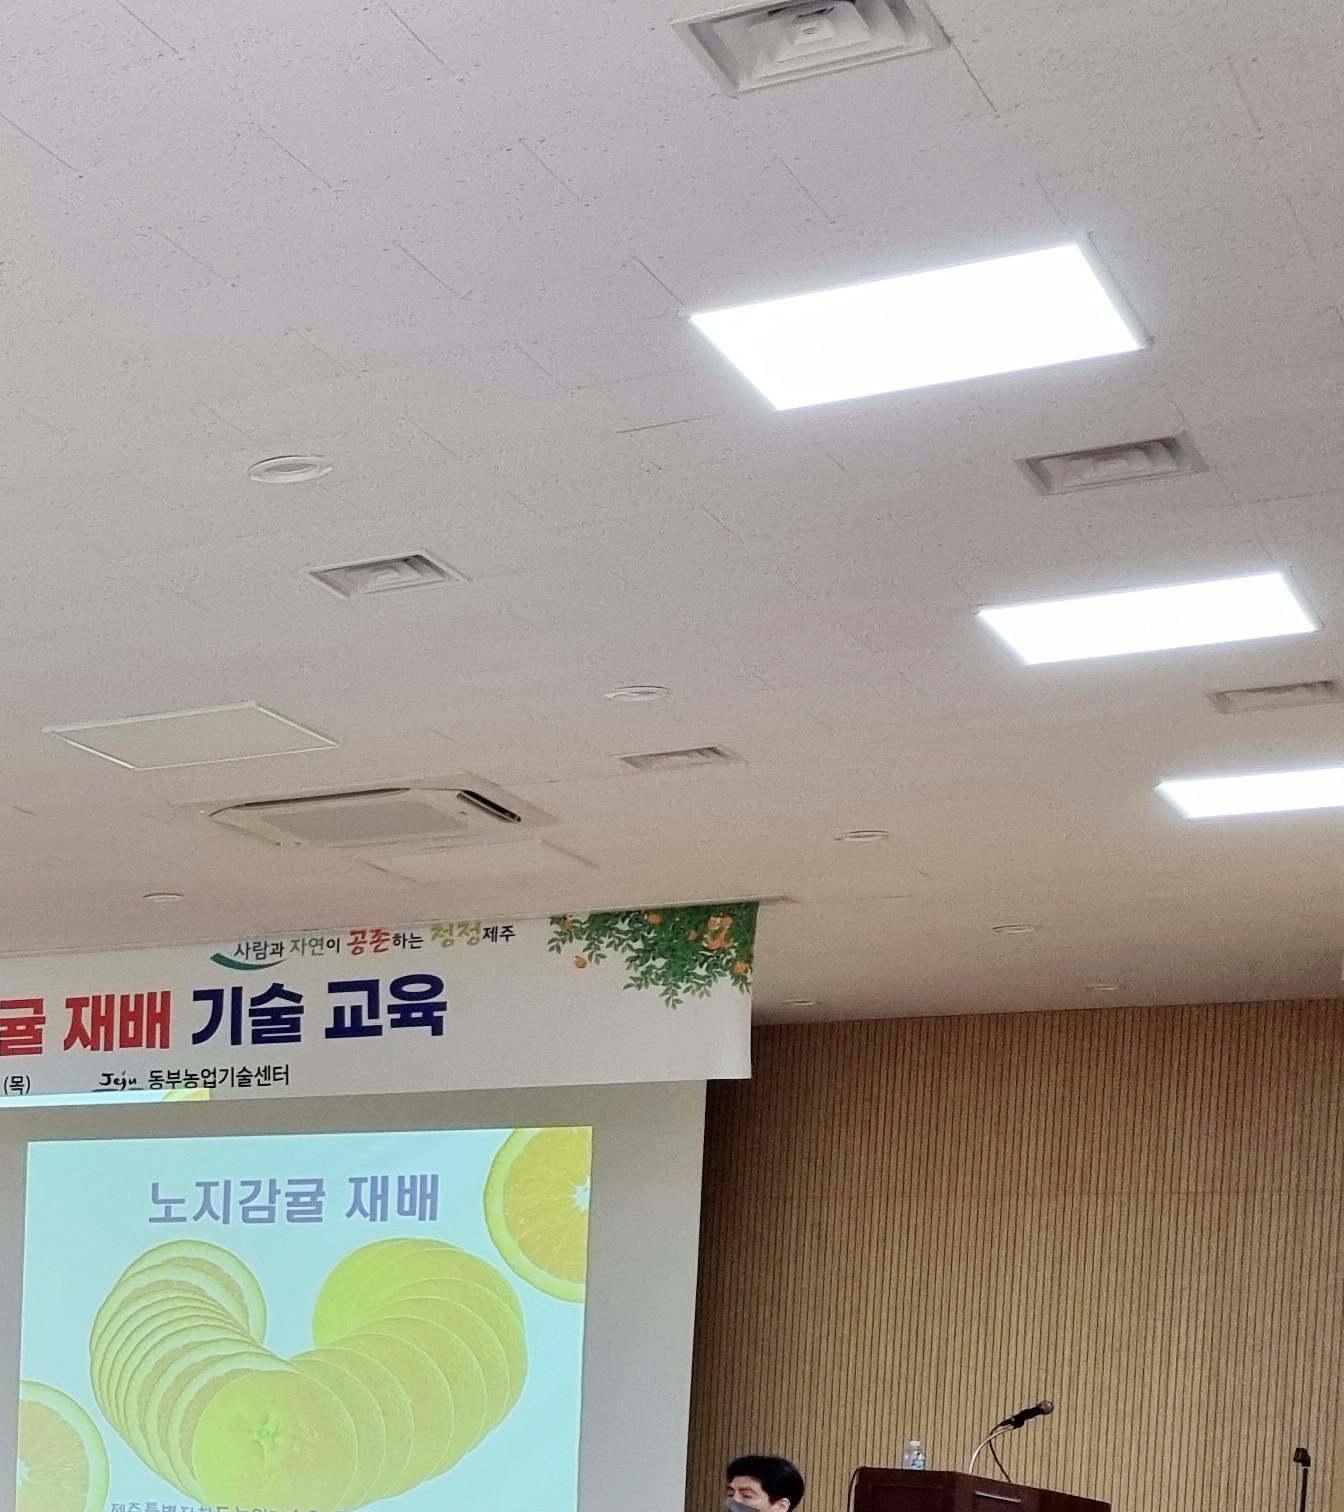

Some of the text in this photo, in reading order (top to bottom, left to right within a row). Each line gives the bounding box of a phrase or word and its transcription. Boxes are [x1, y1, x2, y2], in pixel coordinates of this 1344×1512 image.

[233, 940, 285, 960] 사람과
[289, 937, 341, 956] 자연이
[346, 928, 425, 956] 공존하는
[63, 990, 172, 1052] 재배
[191, 982, 305, 1046] 기술
[323, 973, 448, 1040] 교육
[3, 1075, 31, 1096] (목)
[99, 1070, 137, 1091] Jeju
[148, 1064, 290, 1090] 동부농업기술센터
[148, 1173, 440, 1225] 노지감귤 재배
